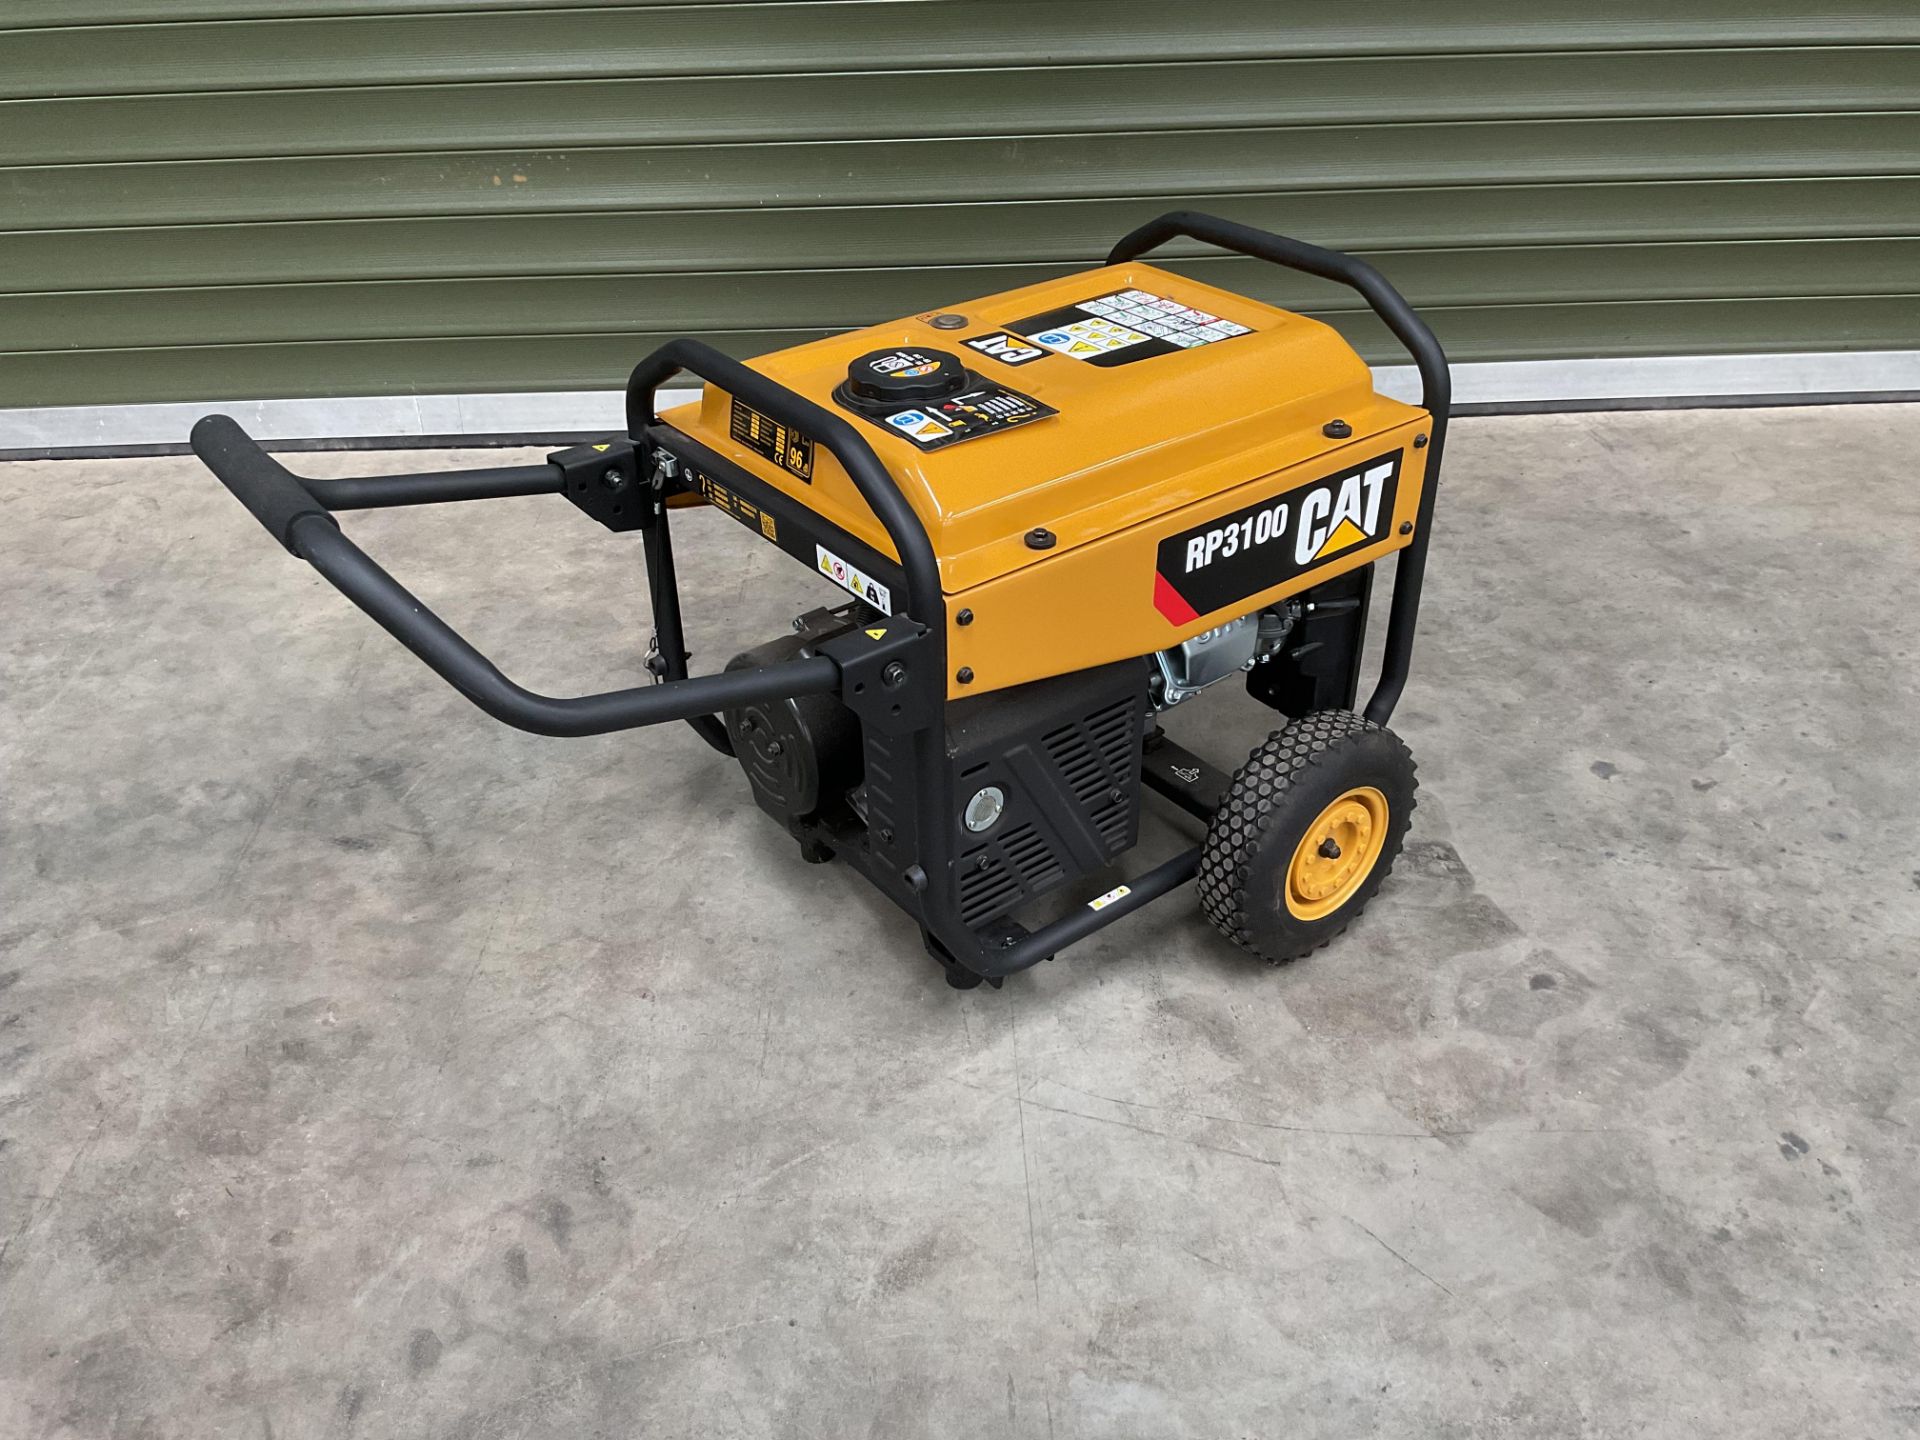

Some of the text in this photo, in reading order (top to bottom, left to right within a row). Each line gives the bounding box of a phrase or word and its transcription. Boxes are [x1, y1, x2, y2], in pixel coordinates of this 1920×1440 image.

[968, 334, 1043, 363] CAT
[774, 452, 784, 467] CE
[789, 446, 804, 469] 96
[1185, 461, 1394, 574] RP3100 CAT
